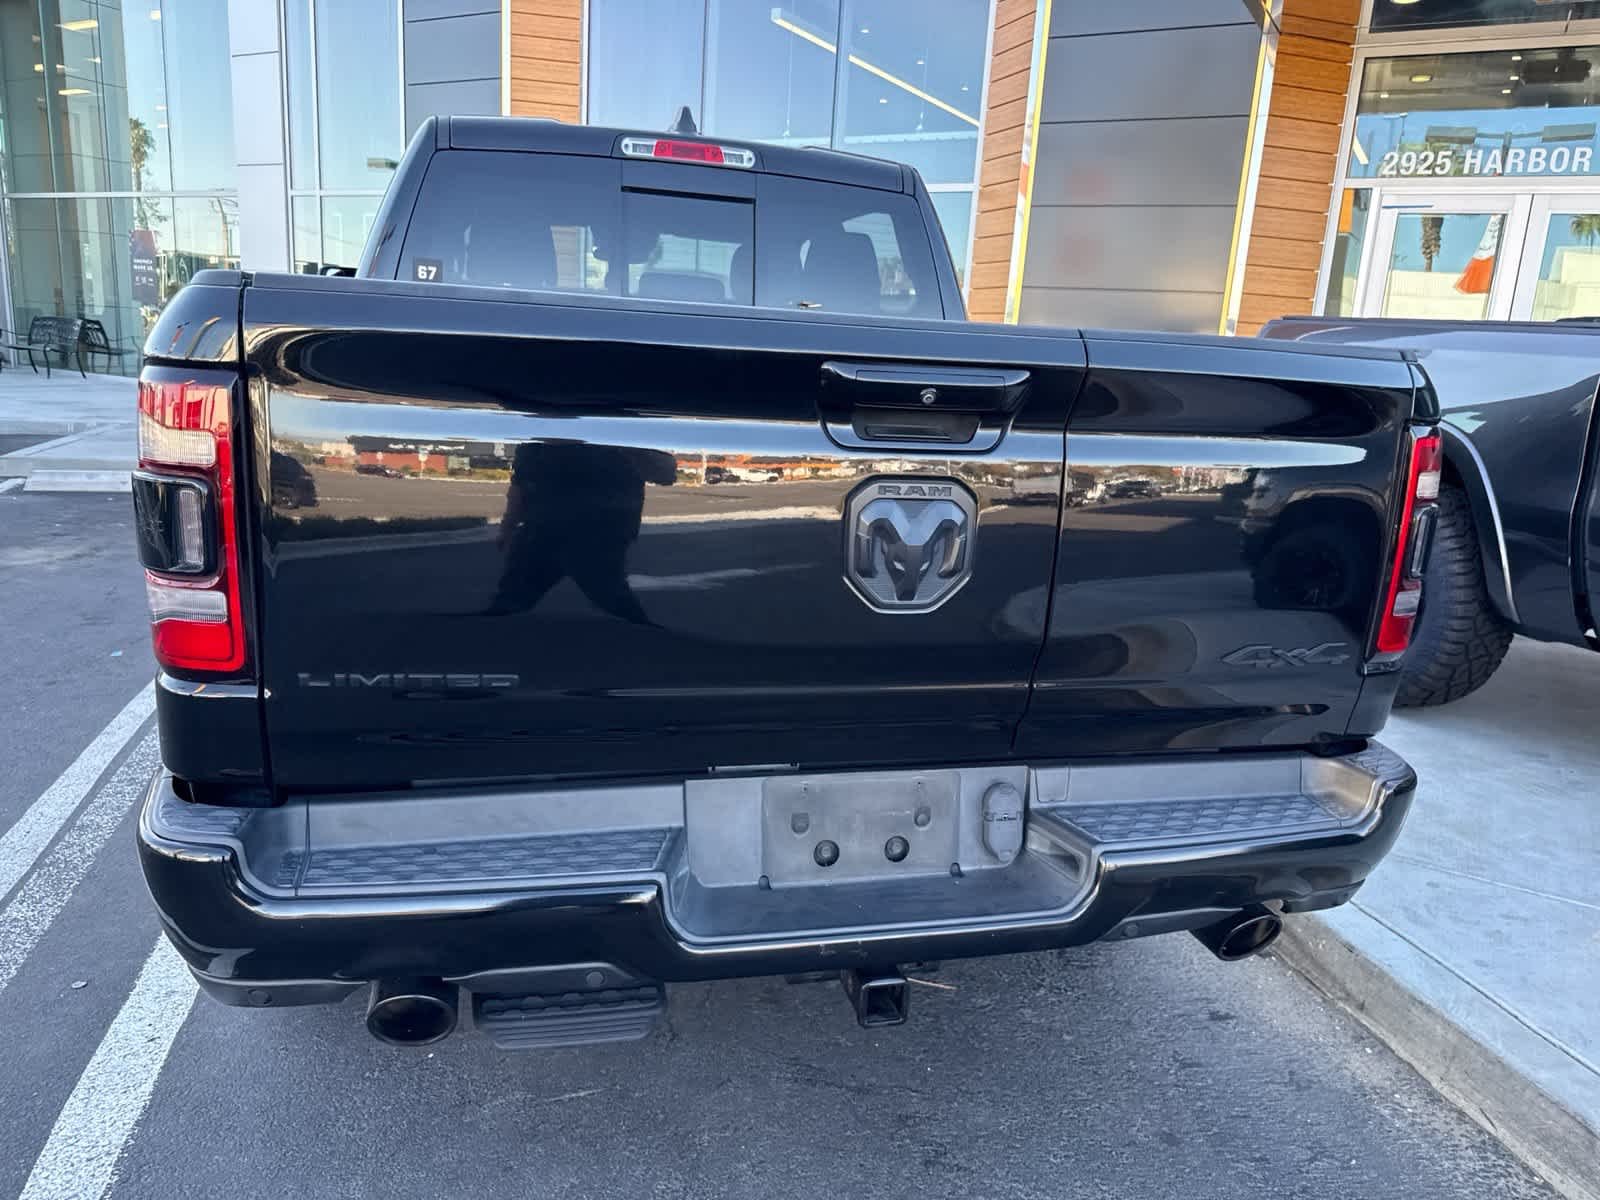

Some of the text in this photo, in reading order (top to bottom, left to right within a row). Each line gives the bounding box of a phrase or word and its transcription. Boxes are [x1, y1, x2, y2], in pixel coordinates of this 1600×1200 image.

[1382, 147, 1593, 176] 2925 HARBOR
[417, 264, 437, 280] 67
[878, 485, 952, 497] RAM
[297, 673, 520, 688] LIMITED
